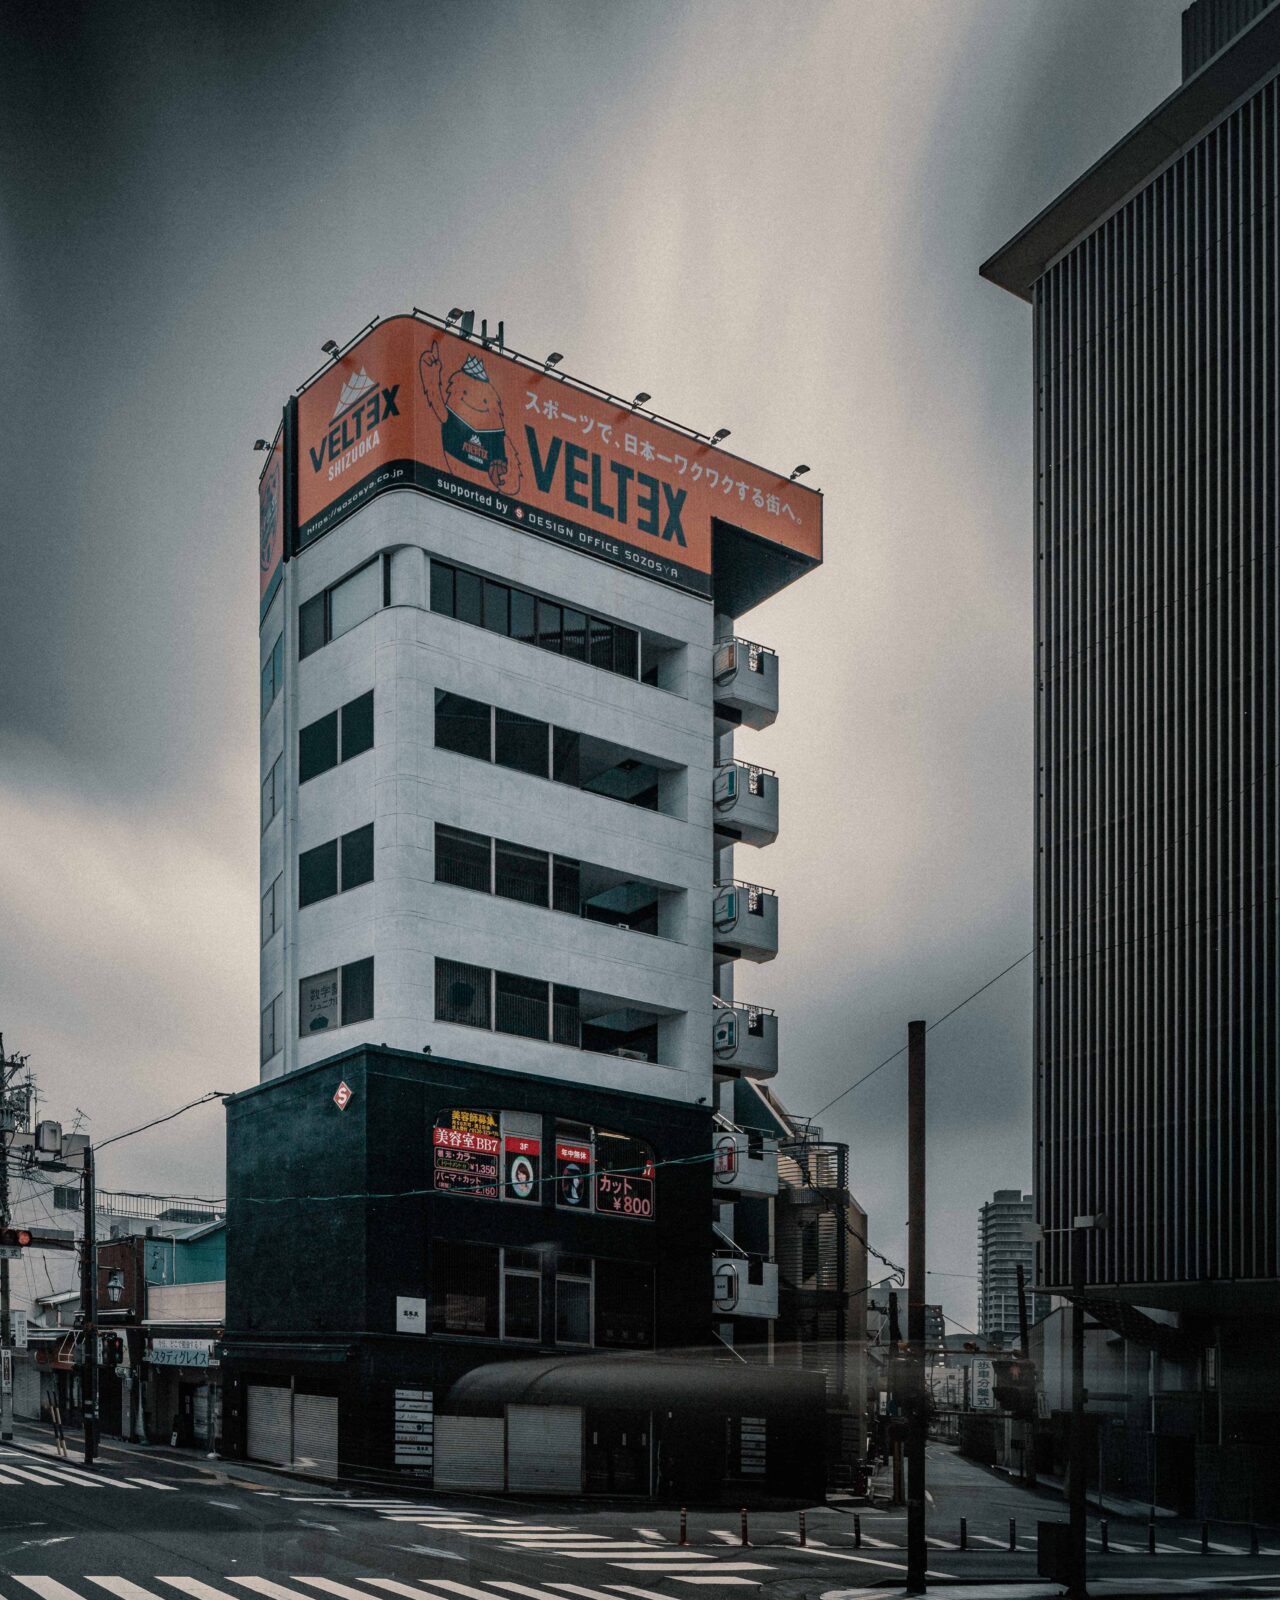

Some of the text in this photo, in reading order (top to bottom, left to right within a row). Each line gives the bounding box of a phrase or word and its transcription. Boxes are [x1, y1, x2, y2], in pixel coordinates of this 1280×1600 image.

[328, 429, 381, 482] SHIZUOKA
[524, 390, 803, 526] スポーツで、日本一ワクワクする街へ。
[306, 468, 404, 536] https://sozosya.co.jp
[437, 478, 492, 507] supported
[495, 499, 508, 514] by
[528, 513, 574, 538] DESIGN
[579, 532, 619, 556] OFFICE
[624, 550, 678, 578] SOZOSYA
[600, 1175, 633, 1195] カット
[613, 1196, 651, 1215] ¥800
